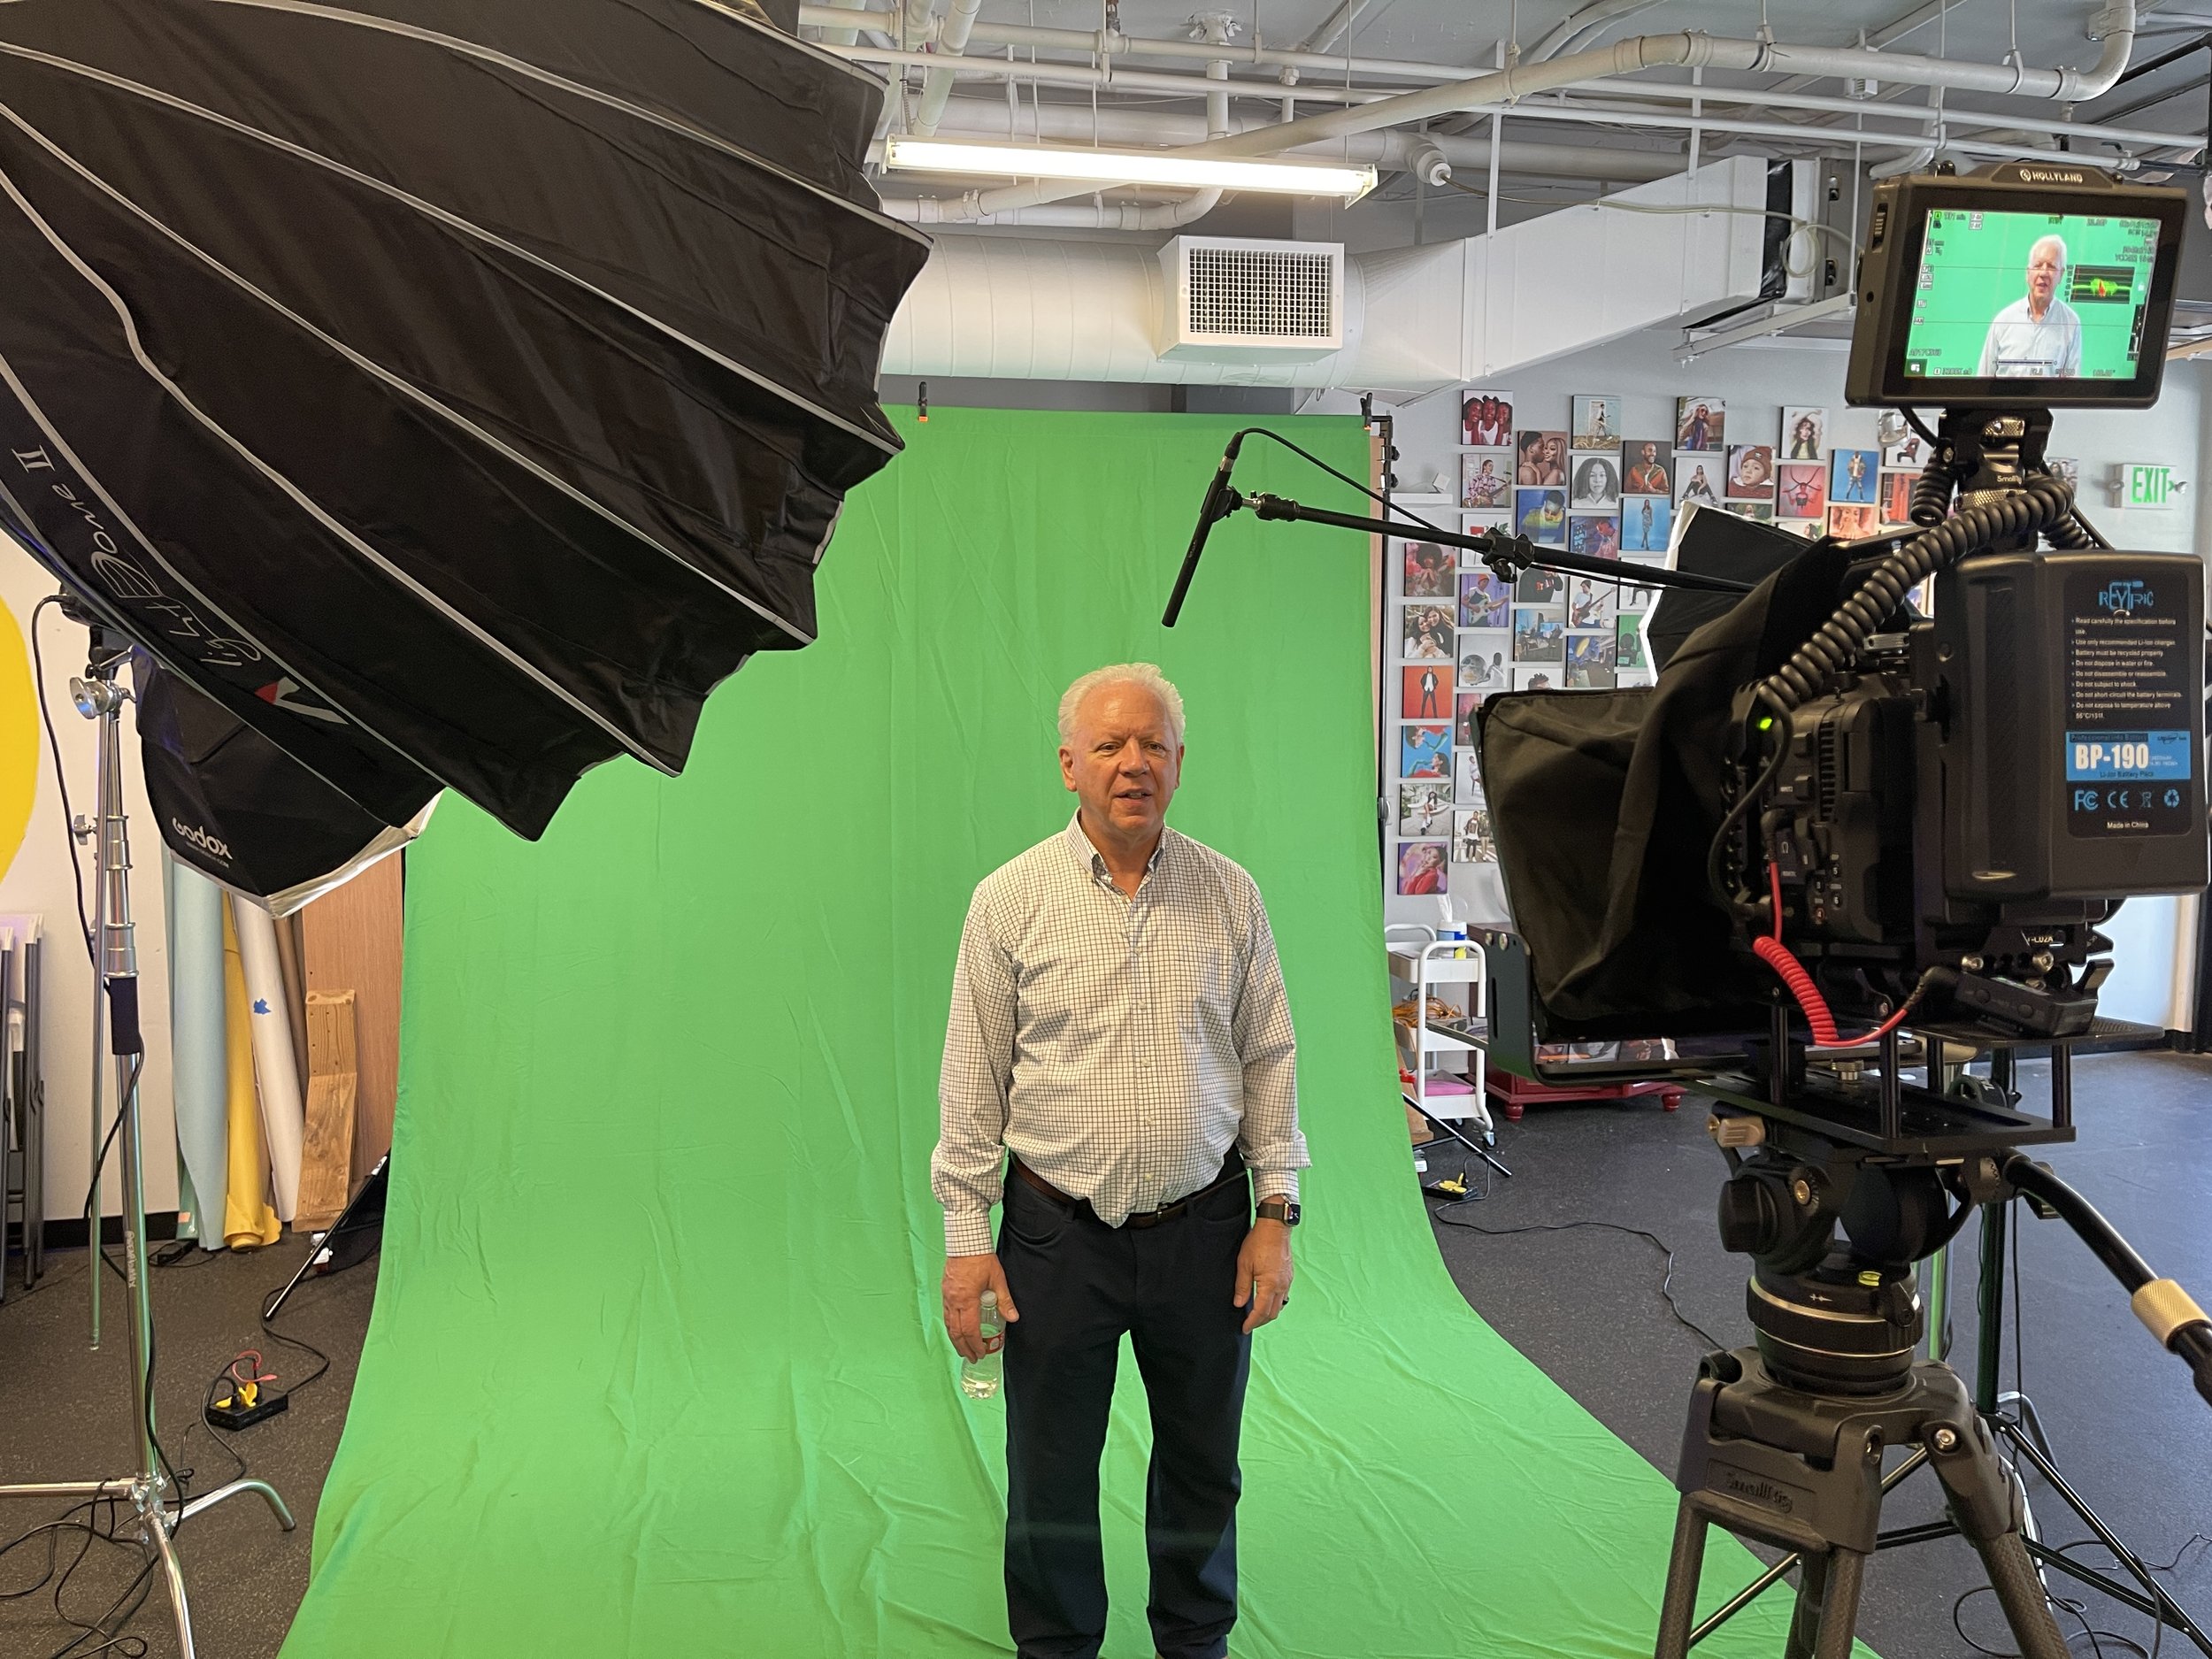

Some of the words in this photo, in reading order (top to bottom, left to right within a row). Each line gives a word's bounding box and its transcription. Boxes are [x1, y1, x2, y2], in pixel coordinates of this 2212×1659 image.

[2032, 171, 2084, 183] HOLLYLAND
[2131, 466, 2170, 503] EXIT
[52, 483, 165, 600] Dome
[2075, 743, 2149, 770] BP-190
